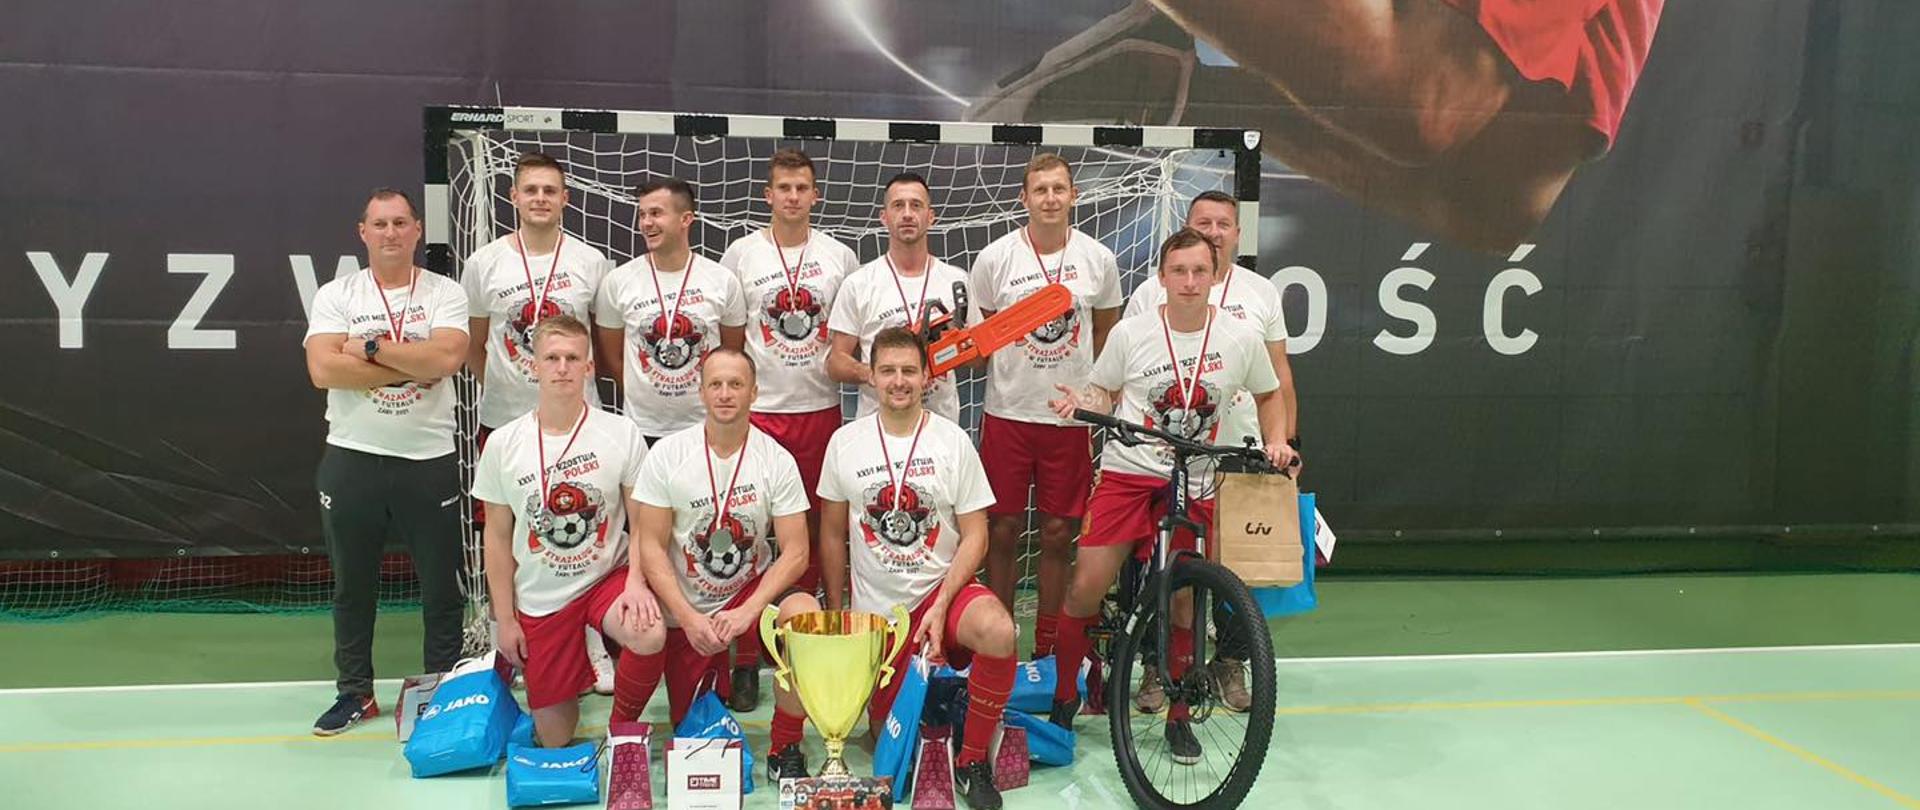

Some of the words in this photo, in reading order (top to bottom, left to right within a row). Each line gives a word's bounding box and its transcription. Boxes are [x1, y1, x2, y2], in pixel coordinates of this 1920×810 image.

[450, 112, 504, 122] ERHARD
[506, 114, 534, 123] SPORT
[544, 279, 572, 294] OLSKI
[678, 295, 705, 307] OLSKI
[1269, 242, 1543, 355] OŚĆ
[1188, 361, 1225, 377] PLSKI
[563, 460, 600, 480] POLSKI
[907, 466, 936, 478] OLSKI
[728, 492, 758, 508] OLSKI
[1245, 522, 1272, 536] Liv
[443, 693, 490, 712] JAKO
[539, 755, 591, 769] JAKO
